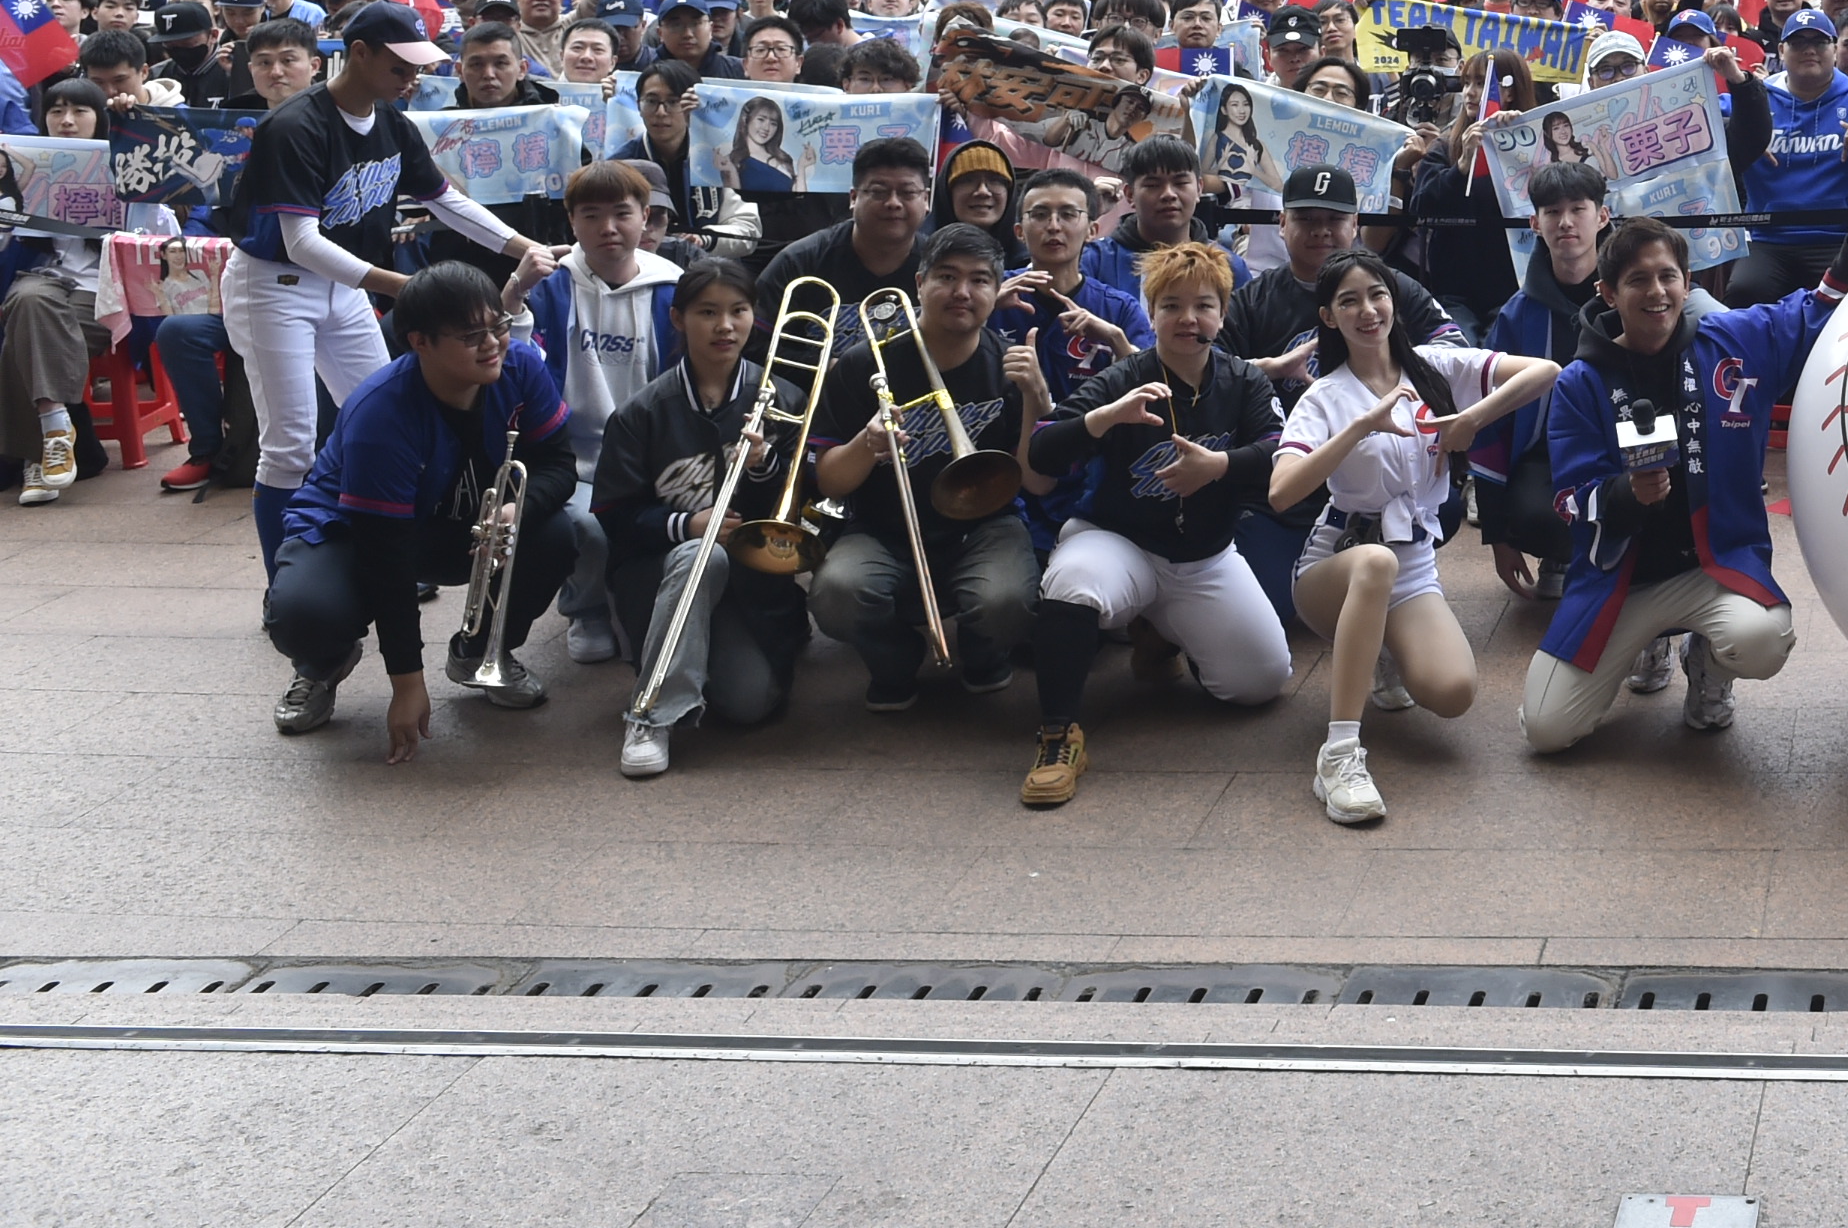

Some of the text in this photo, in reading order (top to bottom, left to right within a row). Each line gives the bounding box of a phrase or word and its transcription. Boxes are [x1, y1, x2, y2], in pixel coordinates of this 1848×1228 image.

[1370, 0, 1464, 32] TEAM
[1373, 55, 1400, 65] 2024
[479, 116, 523, 132] LEMON
[850, 105, 881, 117] KURI
[1316, 115, 1358, 135] LEMON
[1493, 124, 1537, 152] 90
[1620, 110, 1703, 172] 栗子
[1768, 129, 1846, 156] Taiwan
[458, 131, 550, 179] 檸檬
[1649, 185, 1678, 205] KURI
[1707, 228, 1740, 260] 90
[1684, 401, 1705, 475] 心中無敵
[1720, 419, 1751, 430] Taipei
